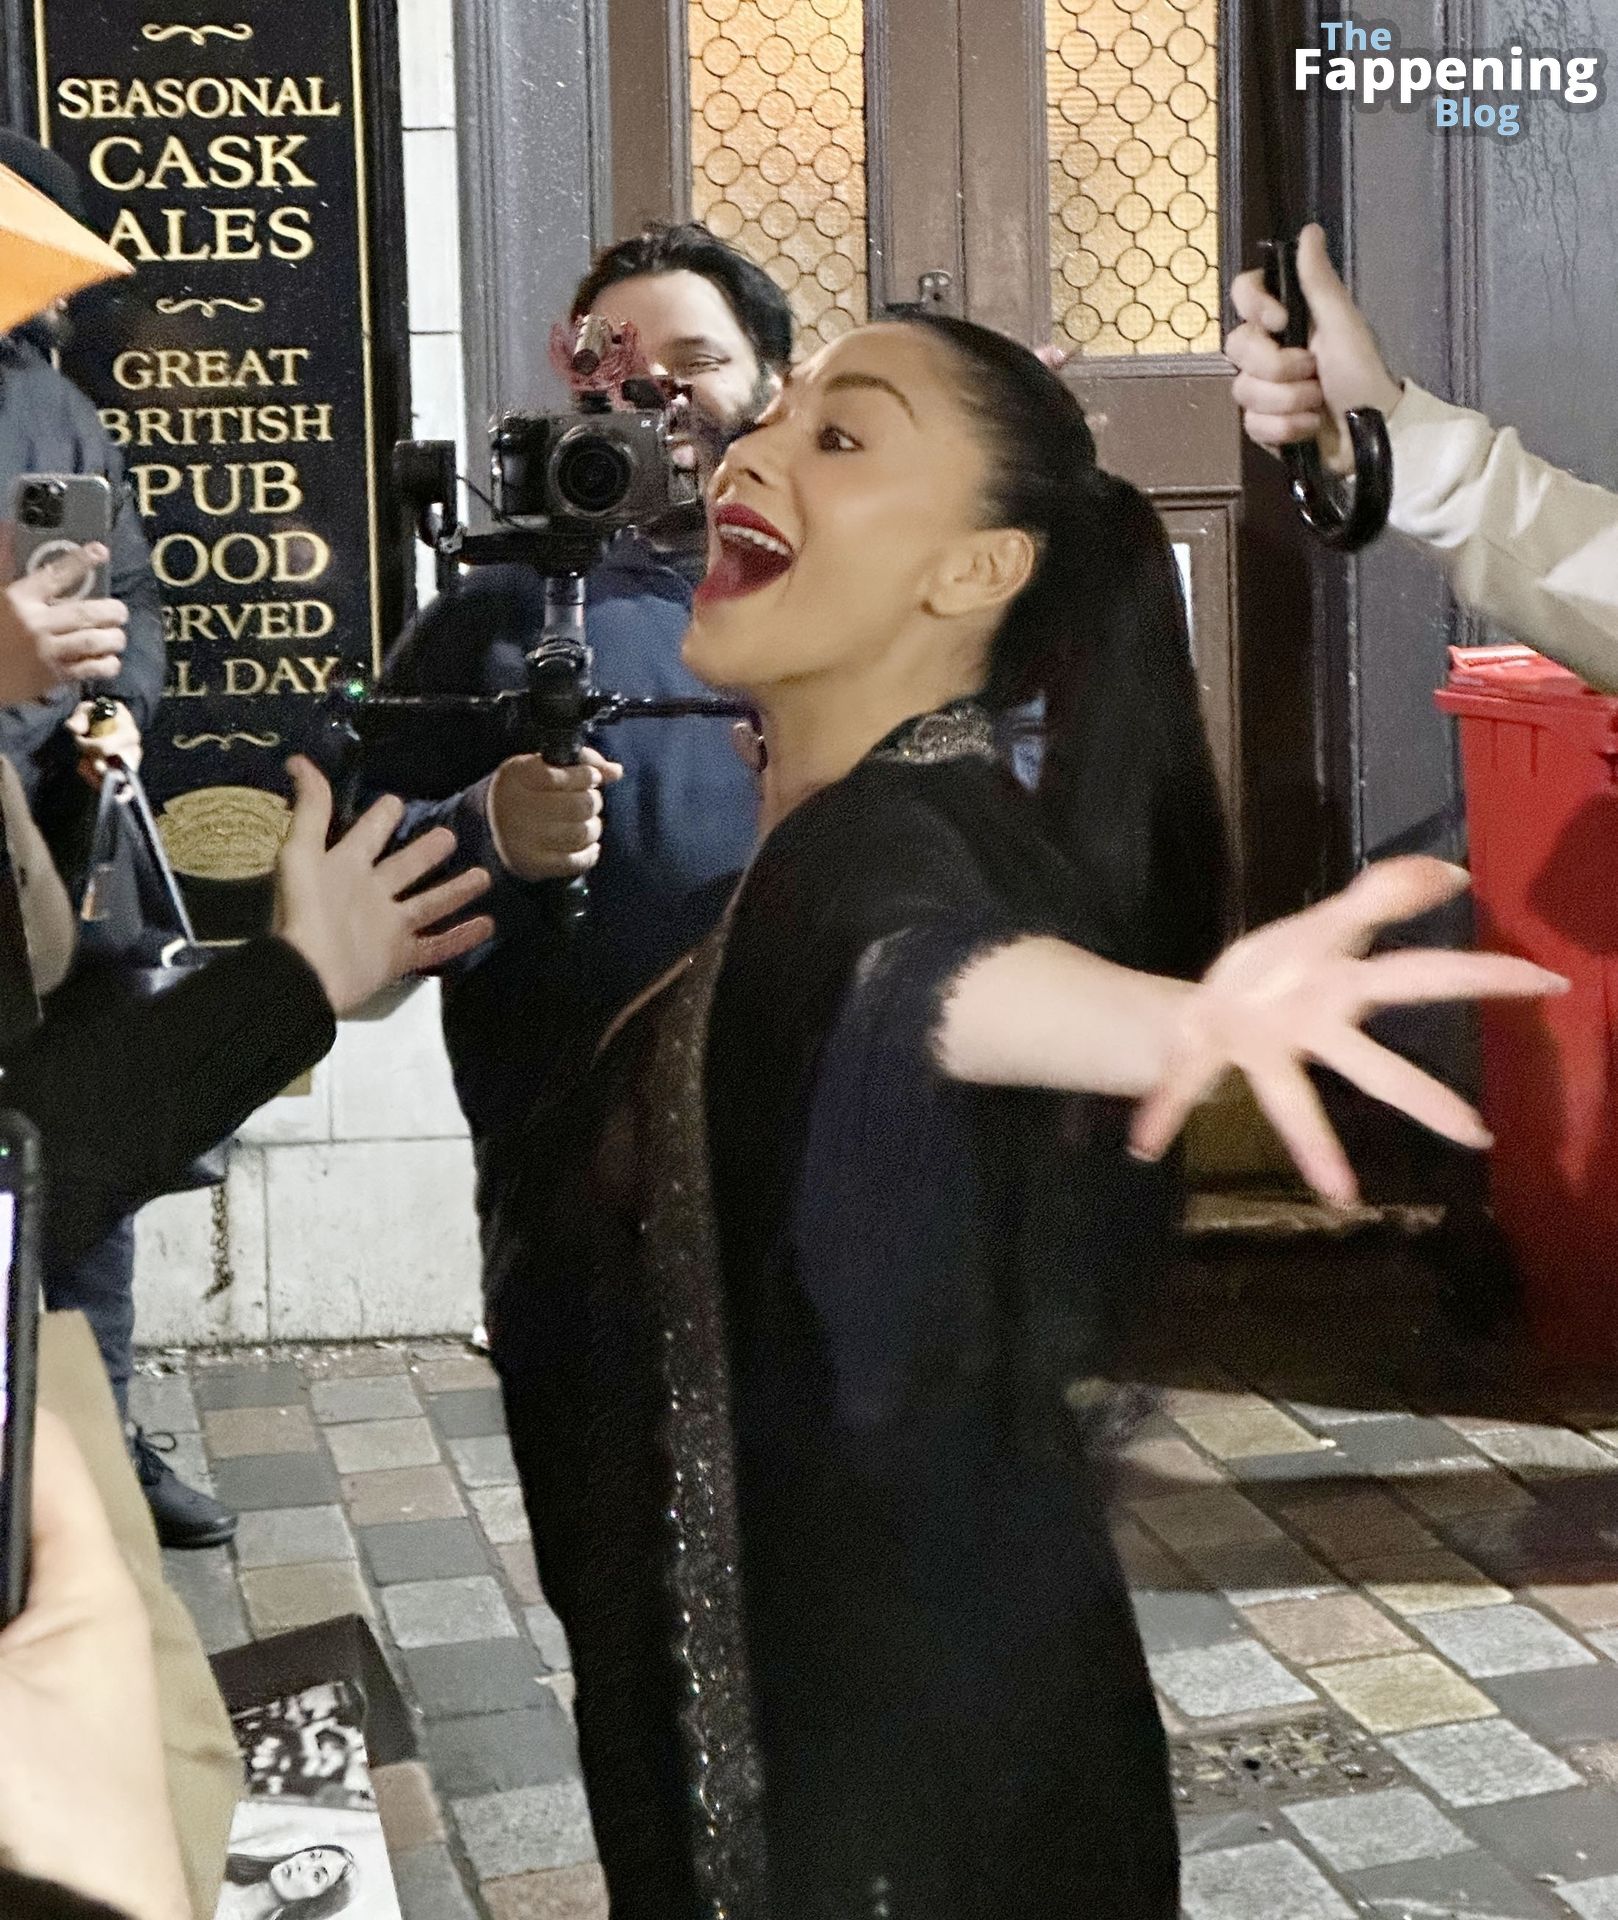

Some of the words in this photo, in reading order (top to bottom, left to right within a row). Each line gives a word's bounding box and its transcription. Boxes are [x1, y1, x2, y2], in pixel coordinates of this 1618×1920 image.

[58, 77, 340, 119] SEASONAL
[89, 136, 316, 190] CASK
[108, 208, 314, 261] ALES
[113, 348, 310, 390] GREAT
[97, 405, 333, 446] BRITISH
[130, 462, 302, 516] PUB
[152, 532, 330, 587] OOD
[223, 657, 339, 695] DAY
